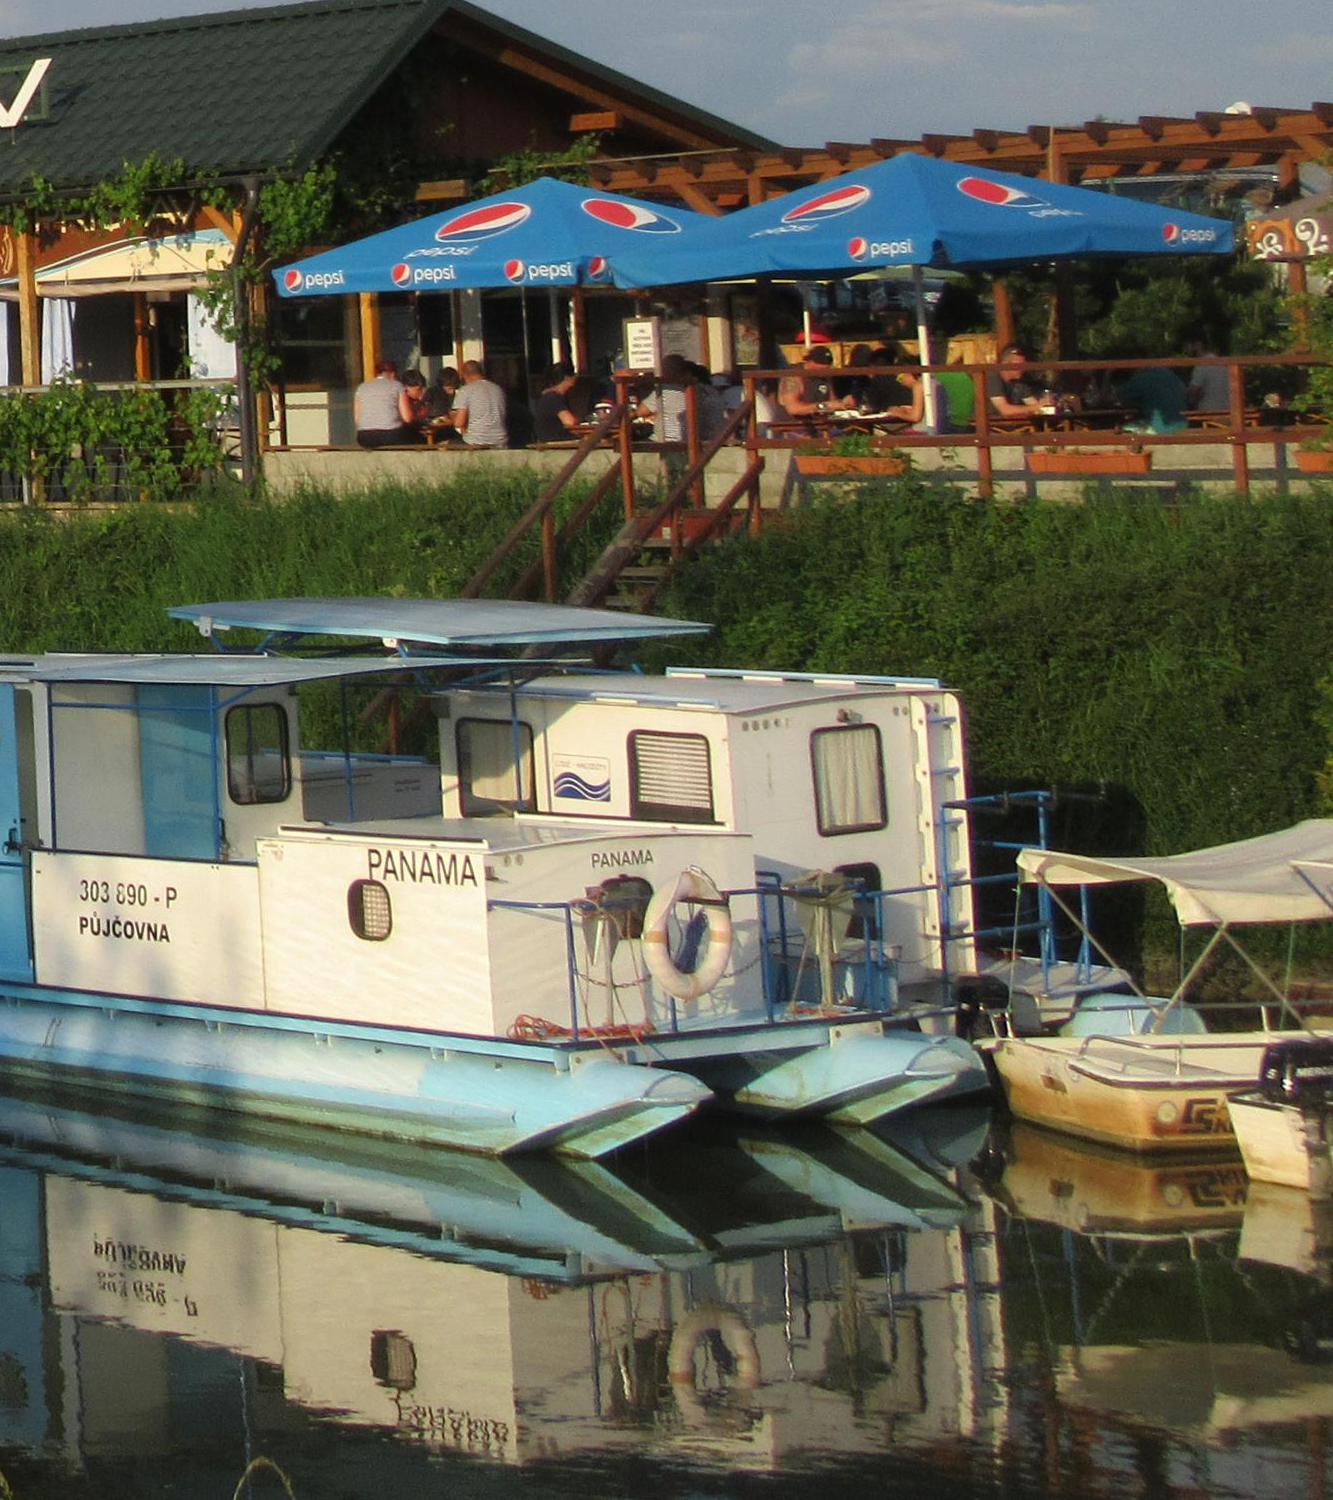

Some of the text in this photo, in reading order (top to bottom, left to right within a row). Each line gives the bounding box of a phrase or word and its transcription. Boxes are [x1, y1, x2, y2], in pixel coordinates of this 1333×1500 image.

[1180, 226, 1217, 244] pepsi
[870, 238, 914, 258] pepsi
[305, 269, 345, 288] pepsi
[413, 264, 456, 284] pepsi
[527, 261, 573, 281] pepsi
[367, 848, 478, 887] PANAMA
[590, 849, 654, 868] PANAMA
[79, 879, 110, 903] 303
[116, 882, 148, 907] 890
[79, 910, 171, 943] PŮJČOVNA
